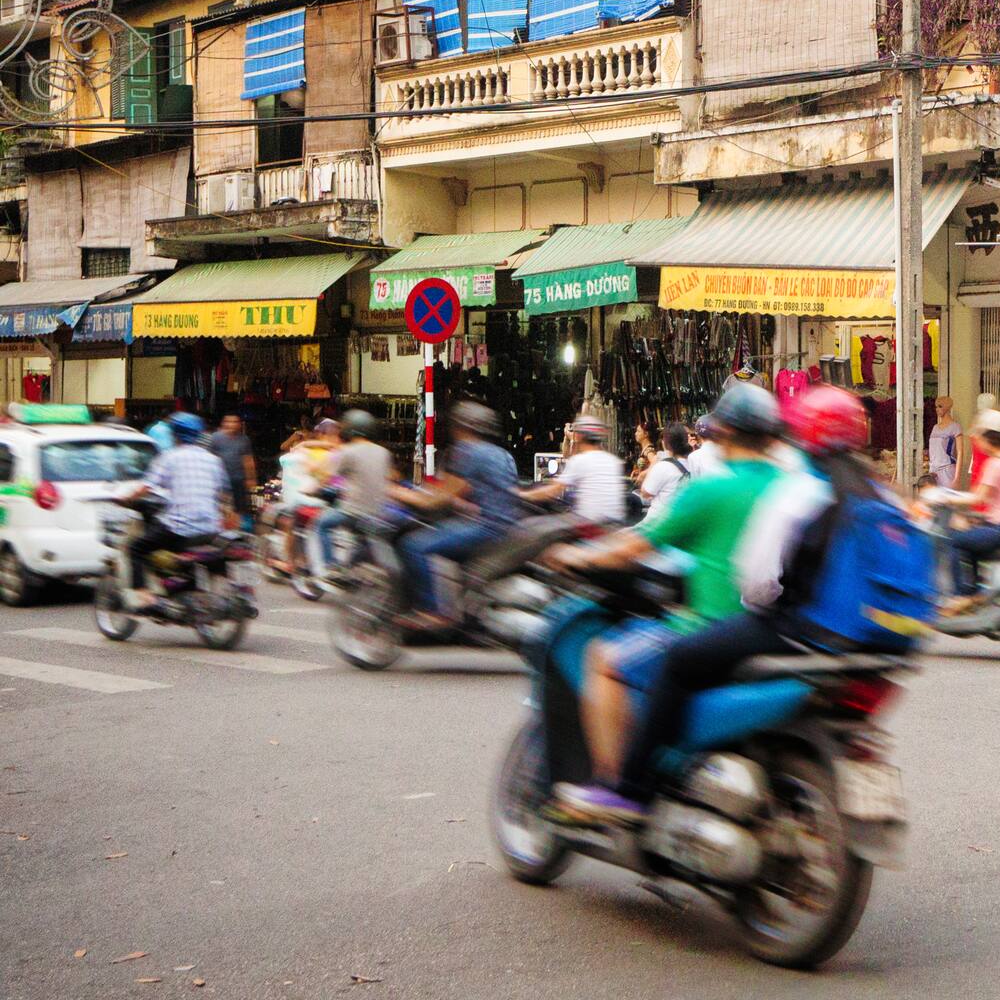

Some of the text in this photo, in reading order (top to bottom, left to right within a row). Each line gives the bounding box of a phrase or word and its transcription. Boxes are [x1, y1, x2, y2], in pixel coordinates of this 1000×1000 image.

[376, 281, 387, 299] 75
[523, 287, 542, 306] 75
[545, 281, 582, 303] HÀNG
[714, 299, 722, 308] 77
[240, 305, 307, 325] THU
